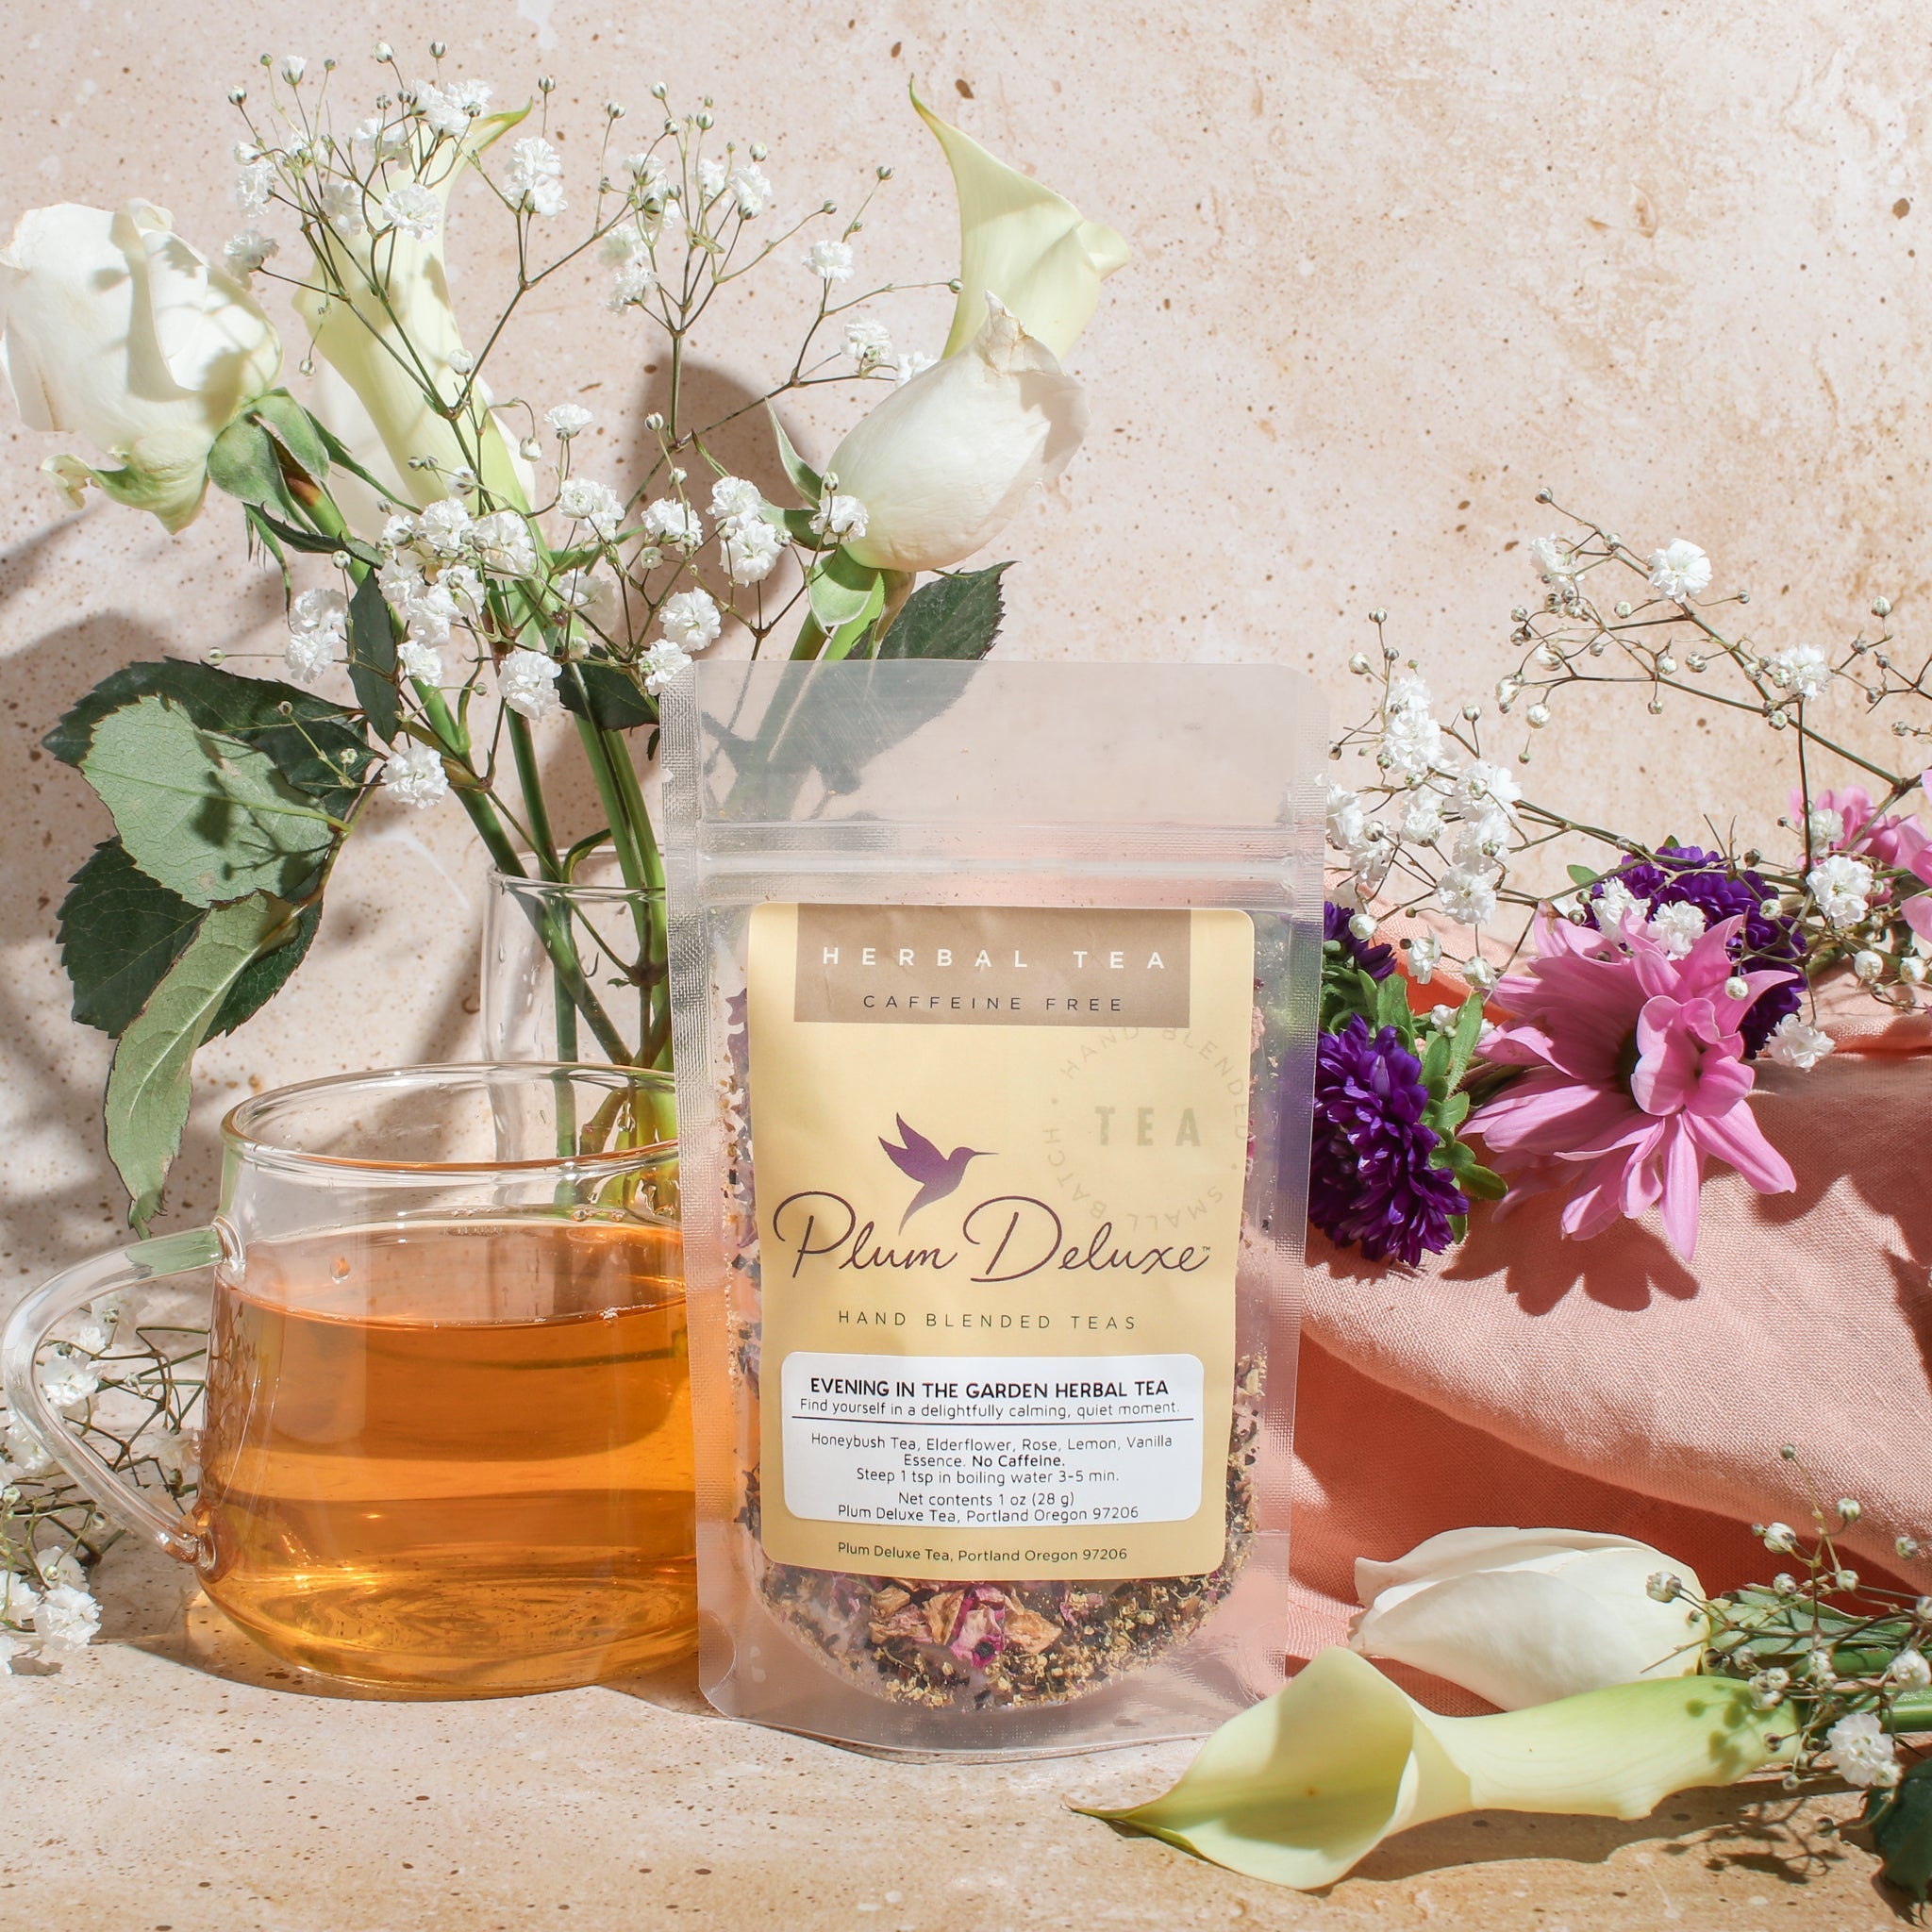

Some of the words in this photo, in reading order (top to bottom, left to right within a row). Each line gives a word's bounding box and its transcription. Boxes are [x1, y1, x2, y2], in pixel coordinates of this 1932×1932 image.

[823, 947, 1027, 969] HERBAL
[1074, 951, 1165, 970] TEA
[863, 994, 1021, 1010] CAFFEINE
[1046, 998, 1121, 1012] FREE
[1060, 1027, 1139, 1079] HAND
[1161, 1027, 1247, 1141] BLENDED
[1095, 1107, 1201, 1146] TEA
[1042, 1128, 1107, 1219] BATCH
[1127, 1185, 1224, 1230] SMALL
[773, 1191, 958, 1278] Plum
[839, 1310, 906, 1325] HAND
[926, 1313, 1050, 1329] BLENDED
[1072, 1316, 1137, 1330] TEAS
[811, 1378, 890, 1396] EVENING
[896, 1381, 915, 1397] IN
[923, 1382, 958, 1398] THE
[966, 1382, 1047, 1399] GARDEN
[1056, 1382, 1126, 1398] HERBAL
[1134, 1380, 1169, 1396] TEA
[800, 1398, 827, 1412] Find
[832, 1399, 886, 1415] yourself
[891, 1402, 903, 1415] in
[908, 1407, 915, 1416] a
[921, 1403, 1003, 1420] delightfully
[1008, 1403, 1072, 1420] calming,
[1076, 1402, 1113, 1419] quiet
[1119, 1401, 1179, 1414] moment.
[811, 1433, 886, 1450] Honeybush
[891, 1437, 921, 1452] Tea,
[926, 1438, 1016, 1453] Elderflower,
[1023, 1438, 1061, 1452] Rose,
[1068, 1437, 1120, 1451] Lemon,
[1126, 1434, 1172, 1448] Vanilla
[904, 1454, 966, 1467] Essence.
[973, 1455, 992, 1467] No
[998, 1454, 1064, 1467] Caffeine.
[857, 1468, 894, 1485] Steep
[900, 1470, 906, 1482] 1
[911, 1472, 933, 1486] tsp
[939, 1471, 950, 1483] in
[957, 1471, 1005, 1487] boiling
[1010, 1472, 1053, 1483] water
[1058, 1470, 1084, 1483] 3-5
[1089, 1469, 1119, 1482] min.
[898, 1491, 924, 1505] Net
[929, 1493, 992, 1506] contents
[999, 1493, 1005, 1506] 1
[1010, 1496, 1026, 1506] oz
[1032, 1491, 1057, 1507] (28
[1061, 1491, 1074, 1507] g)
[839, 1505, 871, 1519] Plum
[876, 1507, 924, 1521] Deluxe
[929, 1508, 960, 1524] Tea,
[966, 1508, 1028, 1523] Portland
[1035, 1507, 1088, 1524] Oregon
[1093, 1506, 1139, 1520] 97206
[839, 1542, 869, 1556] Plum
[874, 1545, 920, 1559] Deluxe
[925, 1549, 953, 1562] Tea,
[958, 1549, 1019, 1561] Portland
[1024, 1549, 1078, 1563] Oregon
[1083, 1548, 1127, 1560] 97206
